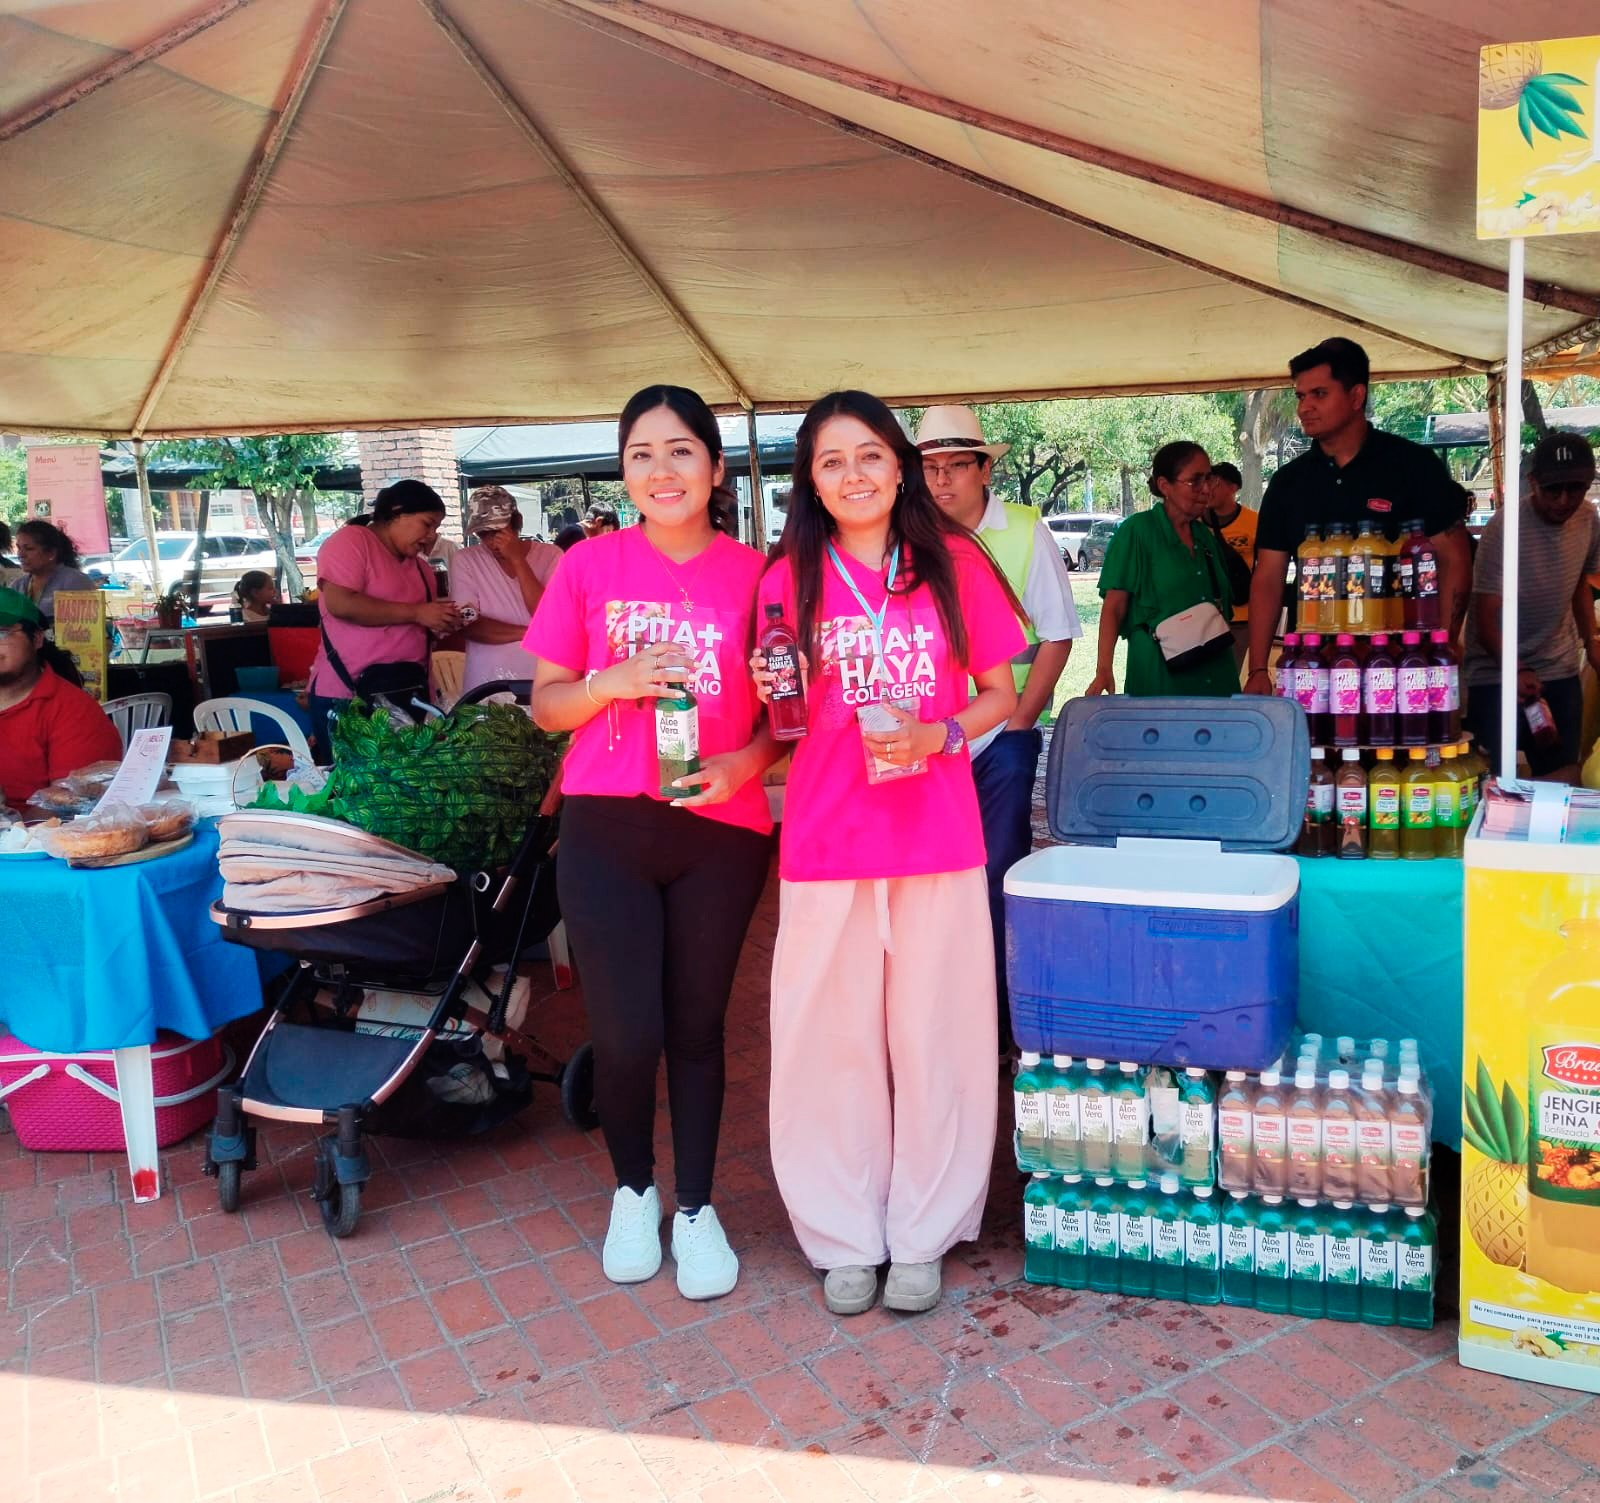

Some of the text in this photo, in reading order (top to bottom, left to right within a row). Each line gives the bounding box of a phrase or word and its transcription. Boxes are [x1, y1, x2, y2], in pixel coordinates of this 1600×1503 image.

[628, 615, 723, 648] PITA+
[836, 624, 934, 658] PITA+
[840, 651, 936, 690] HAYA
[660, 717, 678, 726] Aloe
[660, 725, 679, 734] Vera
[1053, 1100, 1070, 1108] Aloe
[1085, 1102, 1102, 1110] Aloe
[1021, 1106, 1039, 1114] Vera
[1053, 1108, 1070, 1117] Vera
[1119, 1105, 1137, 1113] Aloe
[1085, 1110, 1103, 1118] Vera
[1119, 1112, 1137, 1120] Vera
[1185, 1110, 1204, 1118] Aloe
[1185, 1118, 1204, 1126] Vera
[1552, 1112, 1589, 1129] PIÑA
[1030, 1210, 1047, 1218] Aloe
[1030, 1218, 1047, 1227] Vera
[1061, 1215, 1079, 1224] Aloe
[1093, 1218, 1111, 1227] Aloe
[1061, 1224, 1079, 1232] Vera
[1093, 1226, 1111, 1234] Vera
[1126, 1221, 1144, 1230] Aloe
[1159, 1225, 1177, 1234] Aloe
[1126, 1229, 1144, 1238] Vera
[1159, 1233, 1177, 1242] Vera
[1193, 1230, 1211, 1238] Aloe
[1229, 1231, 1247, 1240] Aloe
[1193, 1237, 1211, 1246] Vera
[1229, 1239, 1247, 1248] Vera
[1262, 1237, 1280, 1246] Aloe
[1296, 1240, 1315, 1249] Aloe
[1262, 1245, 1280, 1254] Vera
[1296, 1247, 1314, 1256] Vera
[1332, 1243, 1351, 1252] Aloe
[1368, 1247, 1388, 1256] Aloe
[1332, 1251, 1351, 1260] Vera
[1369, 1255, 1388, 1264] Vera
[1406, 1251, 1425, 1259] Aloe
[1406, 1258, 1425, 1267] Vera
[1474, 1304, 1483, 1312] No
[1542, 1319, 1572, 1329] personas
